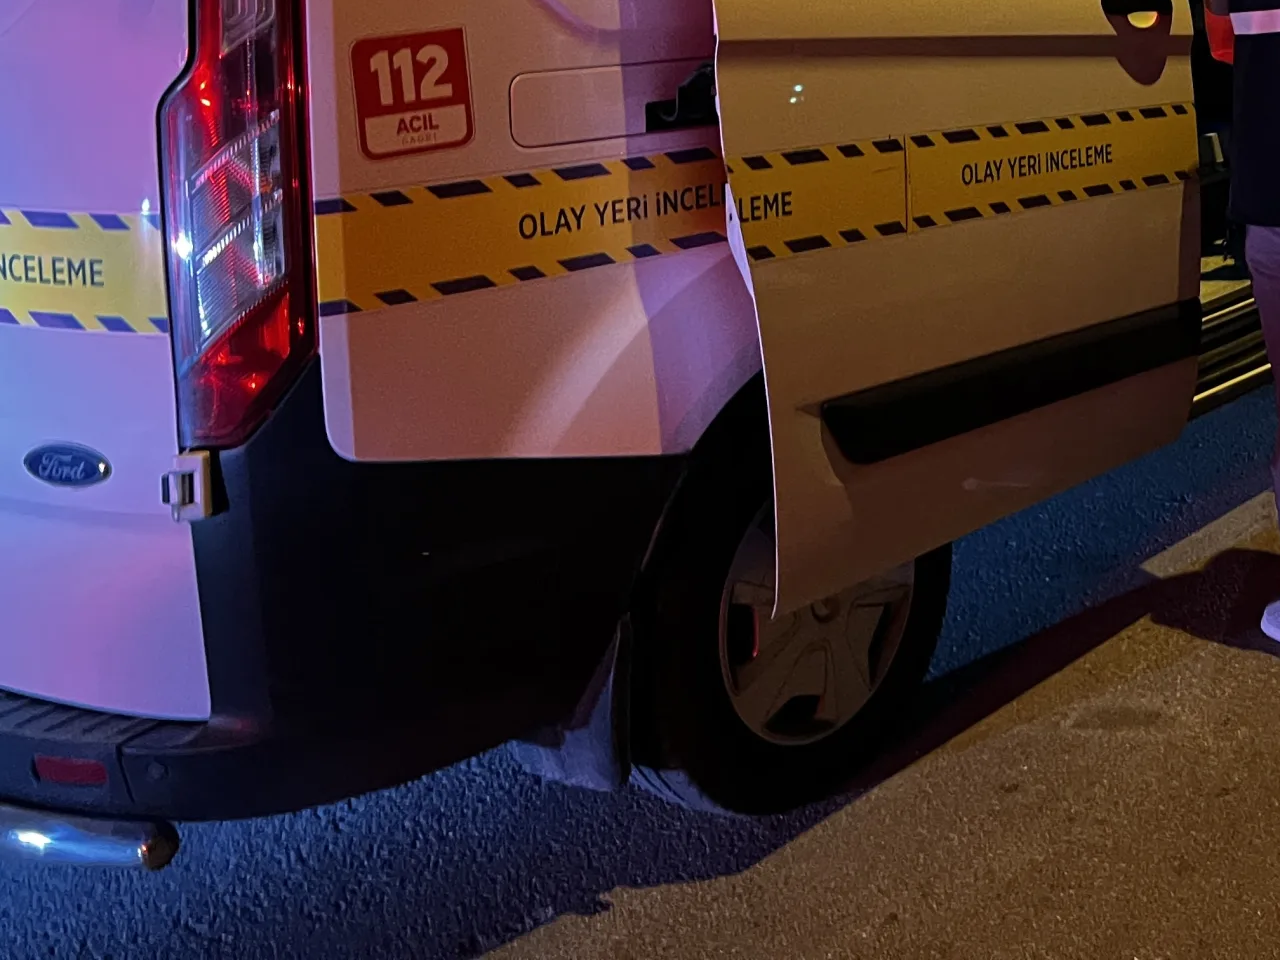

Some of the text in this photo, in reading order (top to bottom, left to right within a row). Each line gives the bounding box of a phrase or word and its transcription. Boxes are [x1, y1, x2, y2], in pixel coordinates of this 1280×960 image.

[370, 44, 453, 106] 112
[961, 159, 1004, 186] OLAY
[519, 204, 587, 239] OLAY
[38, 451, 86, 481] Ford
